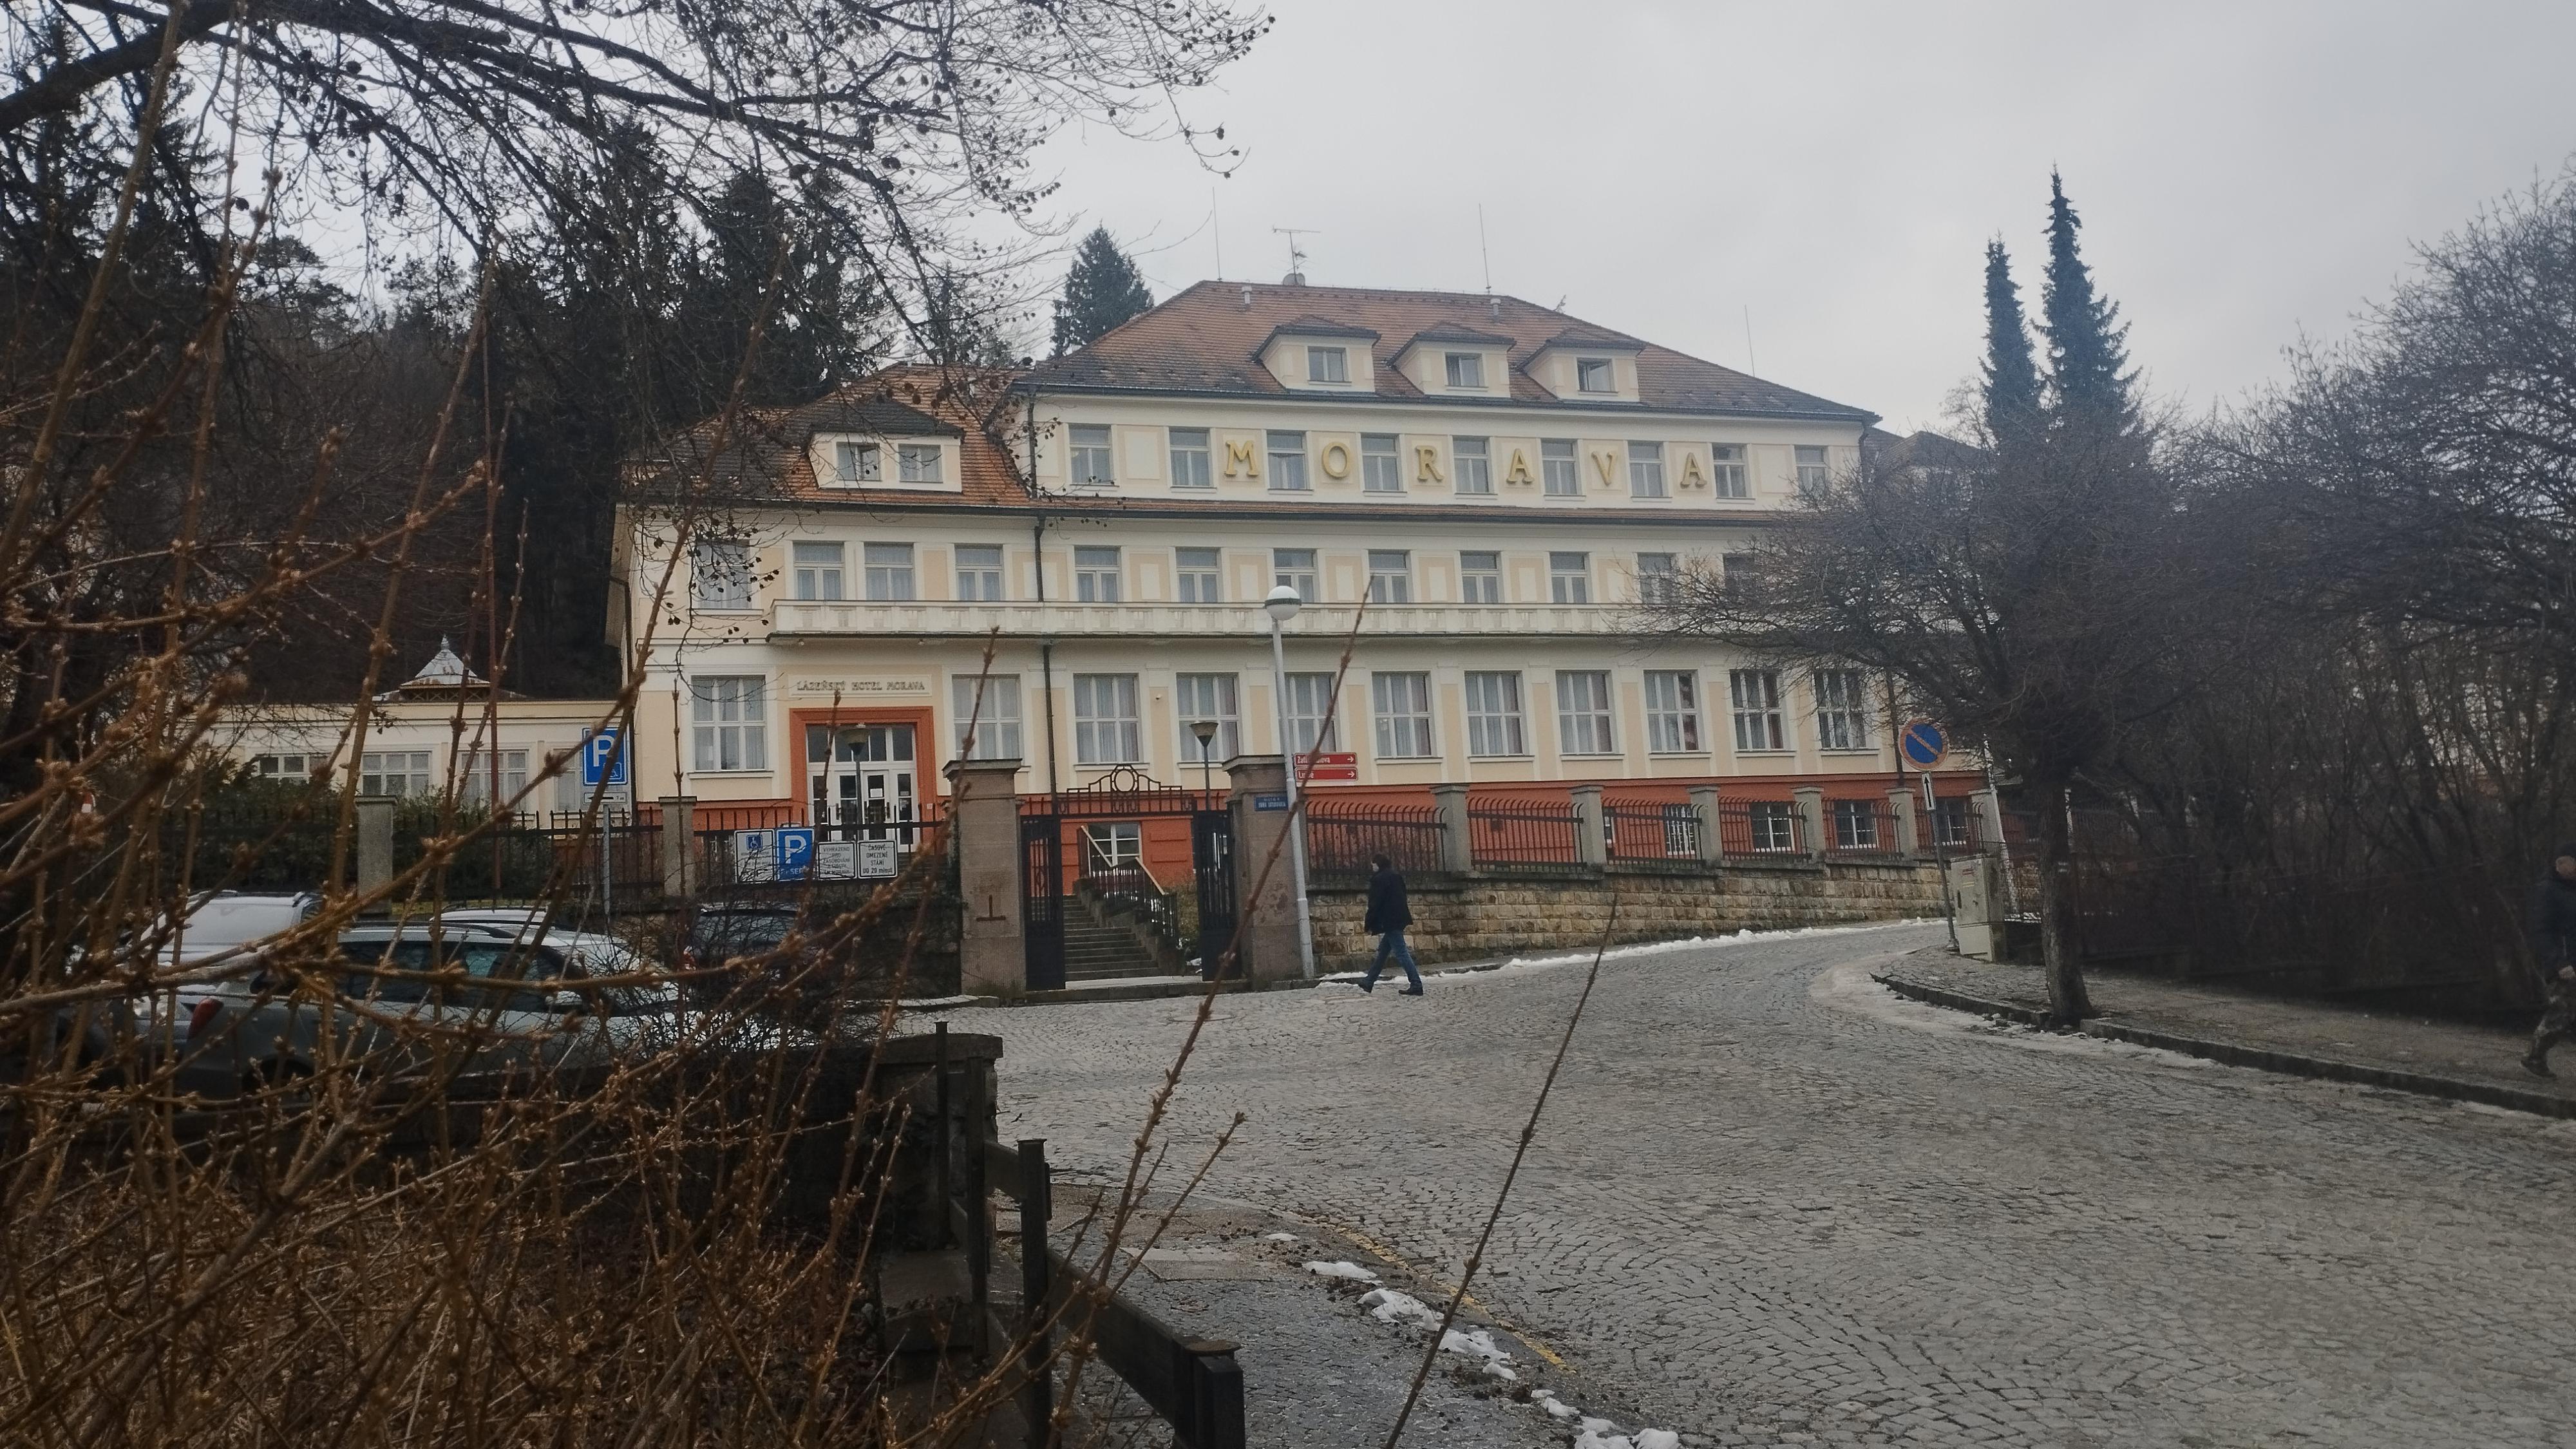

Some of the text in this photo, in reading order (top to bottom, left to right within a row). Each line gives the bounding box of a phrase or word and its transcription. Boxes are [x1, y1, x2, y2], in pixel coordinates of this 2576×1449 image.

[1224, 439, 1709, 489] MORAVA
[851, 681, 882, 690] HOTEL
[886, 681, 925, 690] MORAVA
[785, 835, 807, 864] P
